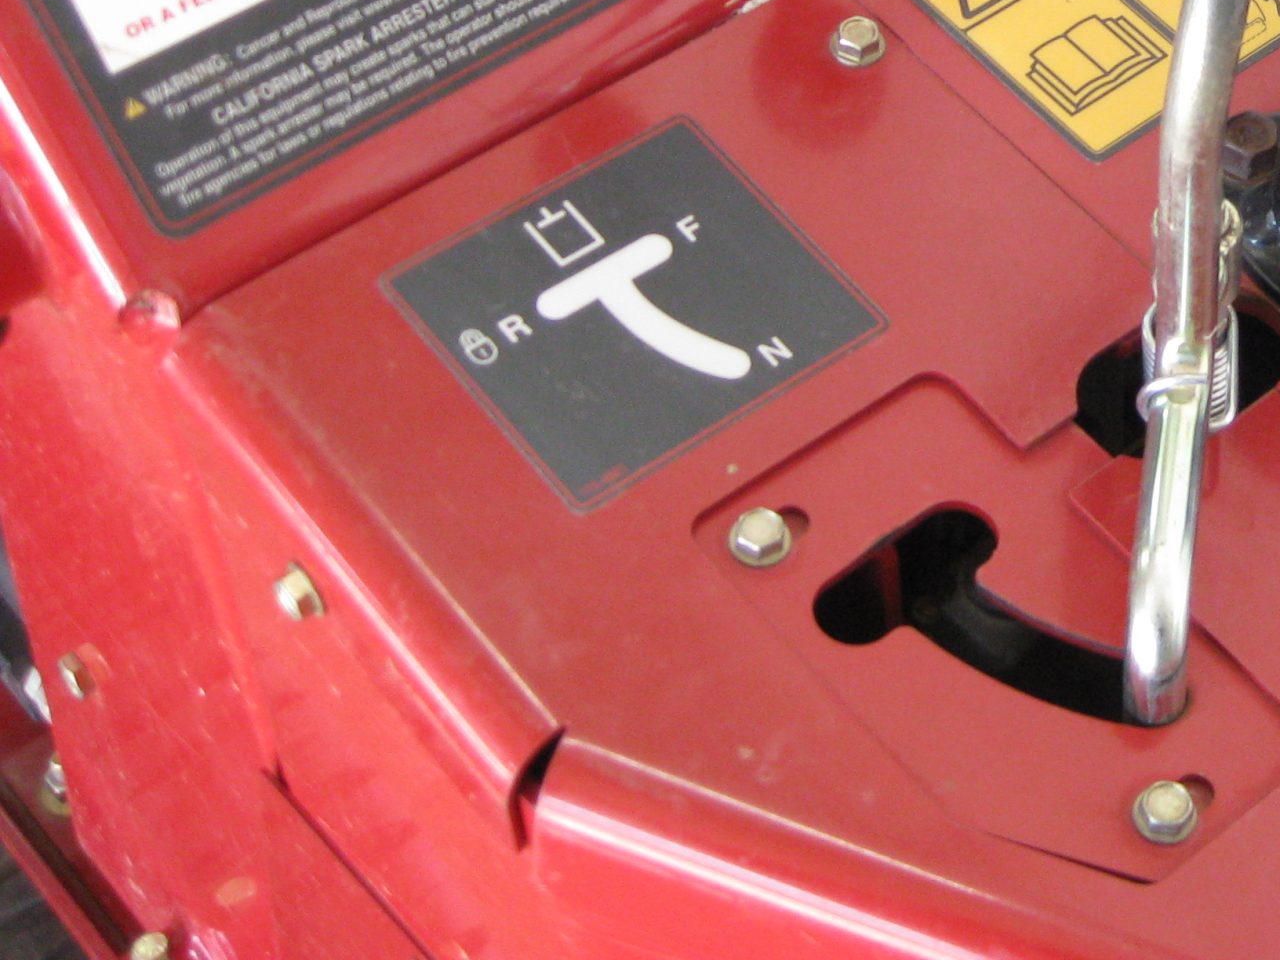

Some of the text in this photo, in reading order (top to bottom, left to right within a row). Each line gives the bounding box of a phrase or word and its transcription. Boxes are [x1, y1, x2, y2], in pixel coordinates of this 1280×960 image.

[125, 16, 156, 39] OR
[160, 7, 175, 23] A
[233, 29, 280, 61] Cancer
[280, 16, 306, 36] and
[153, 136, 220, 180] Operation
[218, 129, 234, 144] of
[232, 115, 260, 137] this
[258, 83, 324, 126] equipment
[322, 70, 351, 91] may
[350, 50, 387, 76] create
[386, 28, 428, 57] sparks
[426, 15, 451, 34] that
[451, 4, 473, 21] can
[164, 99, 189, 119] For
[189, 82, 223, 105] more
[295, 24, 338, 54] please
[336, 10, 362, 29] visit
[210, 61, 315, 125] CALIFORNIA
[311, 31, 370, 72] SPARK
[228, 145, 241, 159] A
[240, 127, 277, 154] spark
[275, 102, 325, 135] arrester
[323, 88, 353, 110] may
[350, 79, 368, 94] be
[421, 36, 444, 55] The
[444, 12, 494, 45] operator
[178, 185, 204, 207] fire
[201, 157, 261, 196] agencies
[257, 146, 278, 164] for
[276, 130, 308, 154] laws
[306, 123, 323, 138] or
[321, 88, 390, 132] regulations
[387, 64, 434, 96] relating
[432, 55, 447, 70] to
[446, 43, 468, 62] fire
[466, 12, 529, 53] prevention
[676, 214, 701, 242] F
[498, 314, 533, 342] R
[758, 336, 793, 367] N
